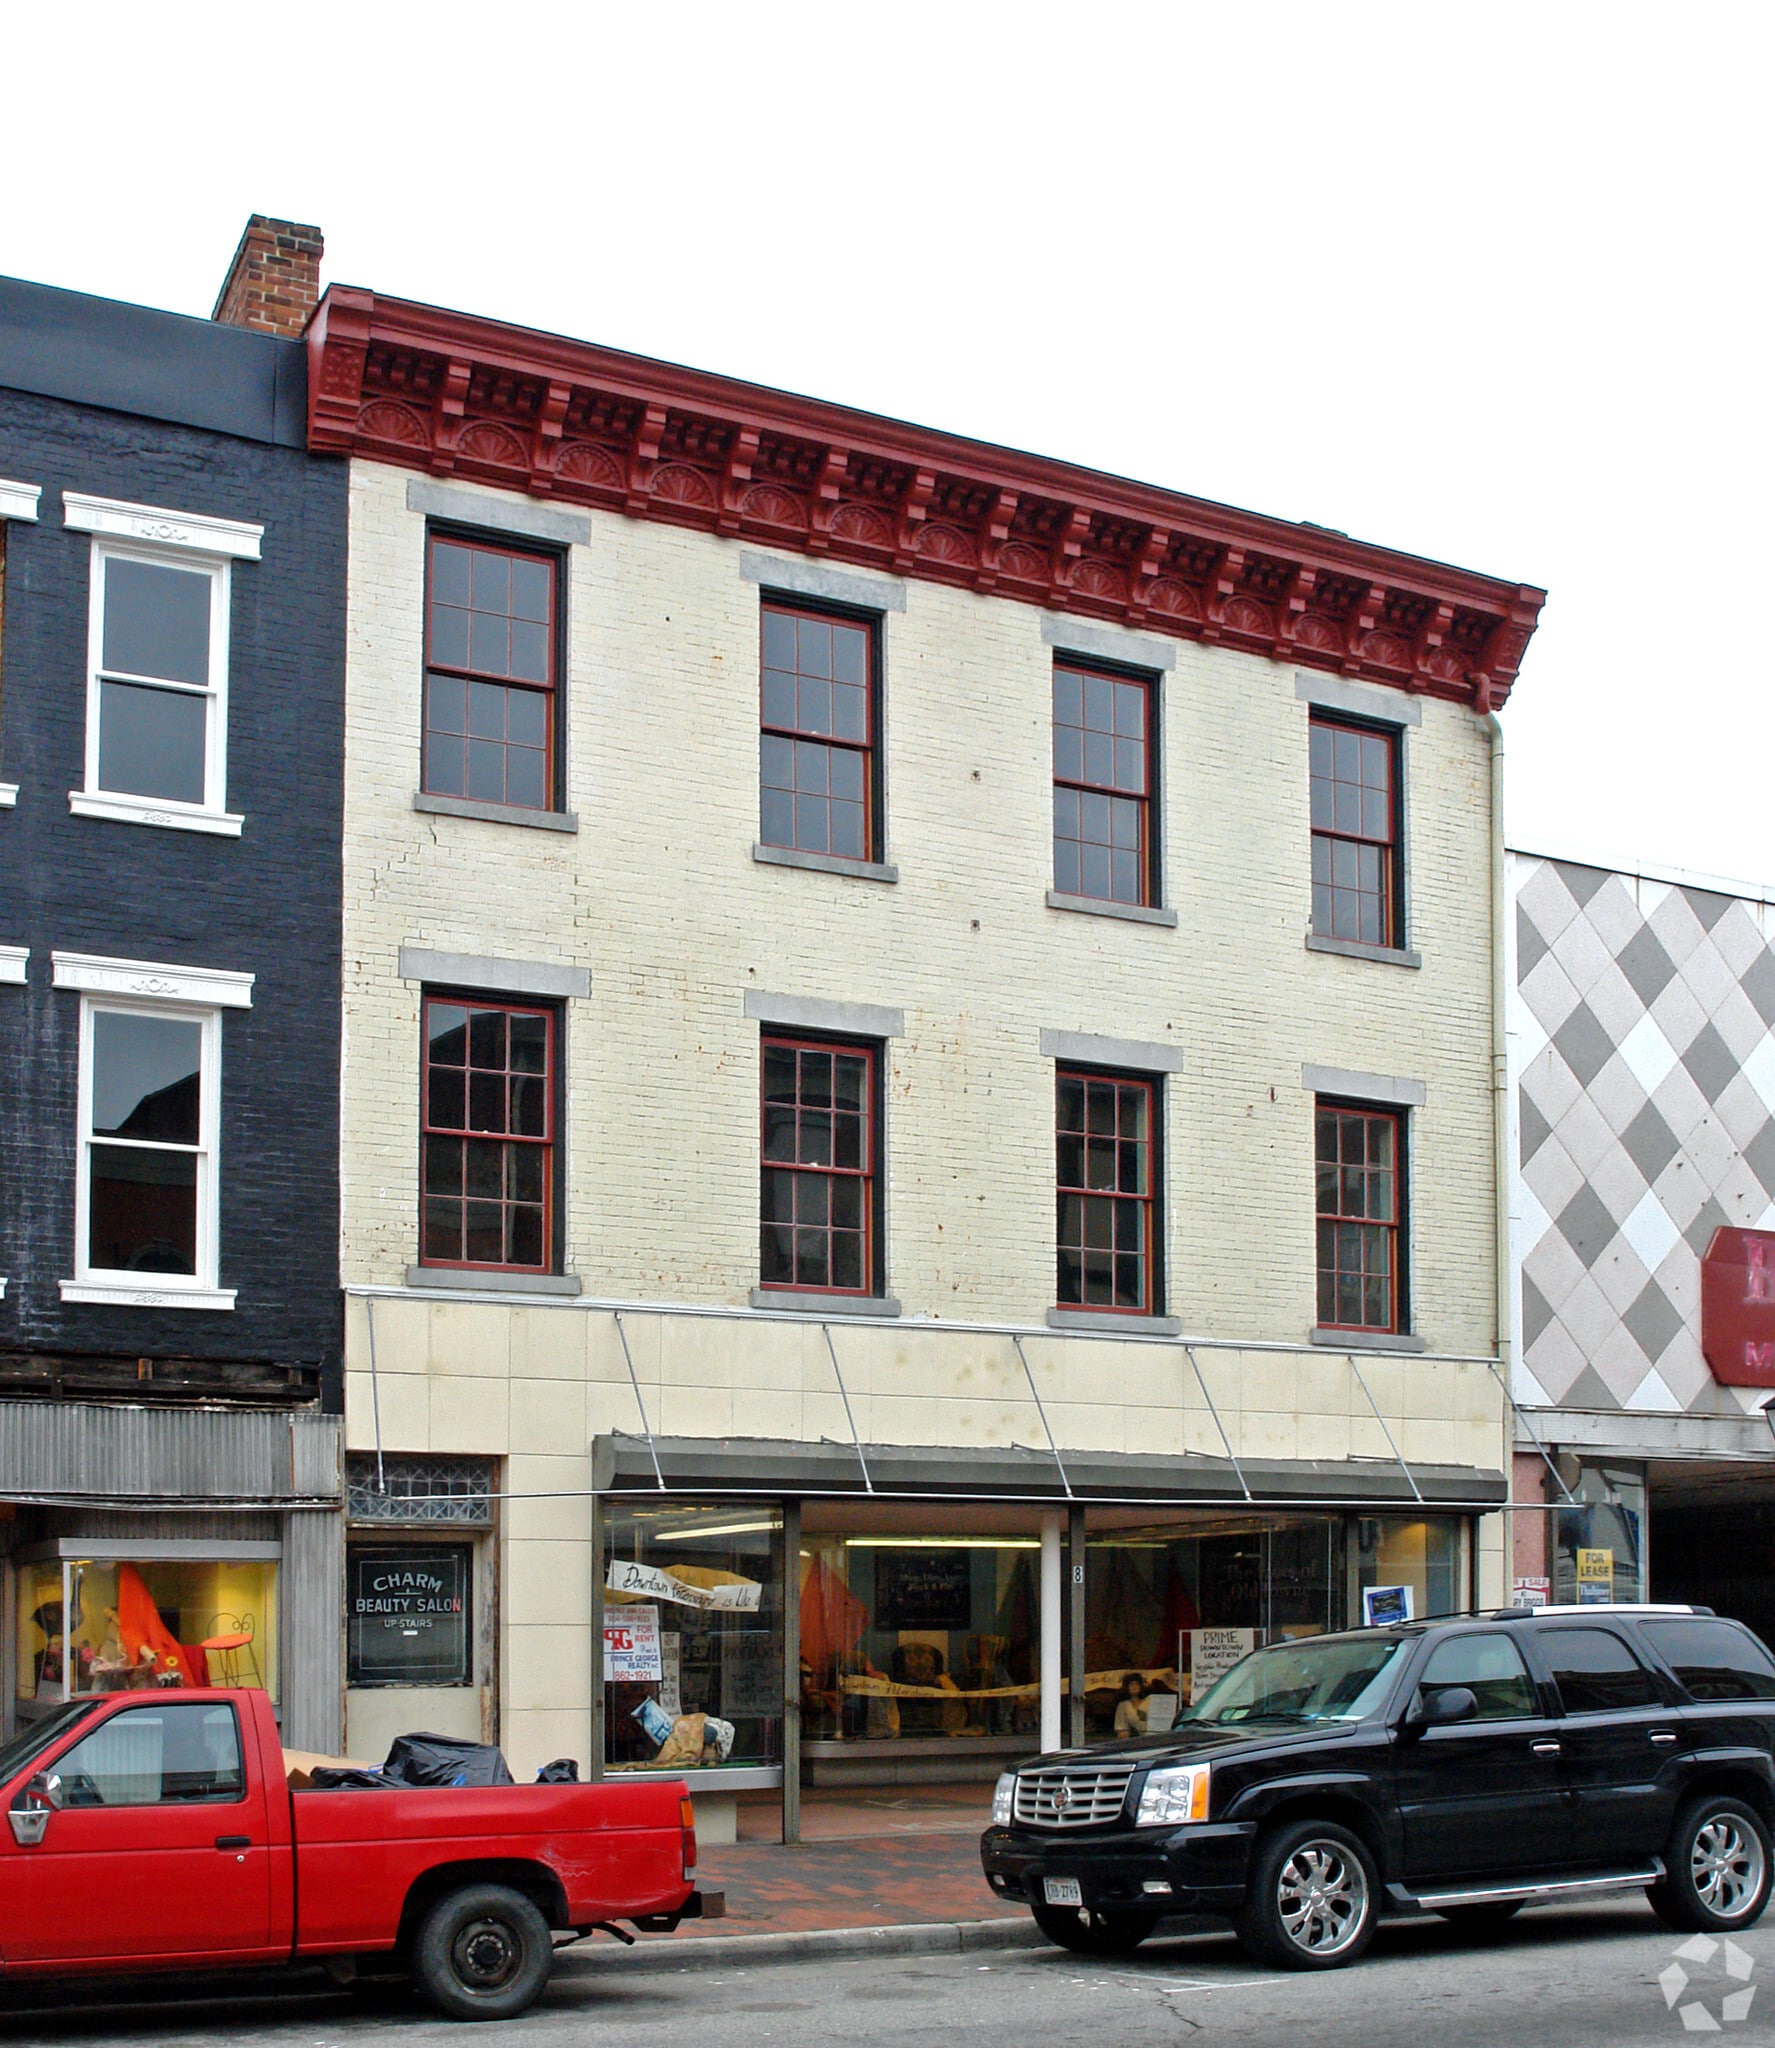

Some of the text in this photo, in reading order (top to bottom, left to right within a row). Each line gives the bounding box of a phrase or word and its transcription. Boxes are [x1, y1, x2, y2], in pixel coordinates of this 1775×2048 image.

[1585, 1552, 1605, 1564] FOR
[1074, 1566, 1082, 1582] 8
[1581, 1565, 1610, 1577] LEASE
[373, 1572, 443, 1593] CHARM
[622, 1564, 668, 1594] Downtown
[355, 1598, 461, 1613] BEAUTY SALON
[636, 1625, 653, 1634] FOR
[1203, 1631, 1239, 1644] PRIME
[1200, 1644, 1244, 1652] DOWNTOWN
[610, 1654, 659, 1662] PRINCE GEORGE
[1204, 1651, 1240, 1659] LOCATION
[628, 1662, 650, 1670] REALTY
